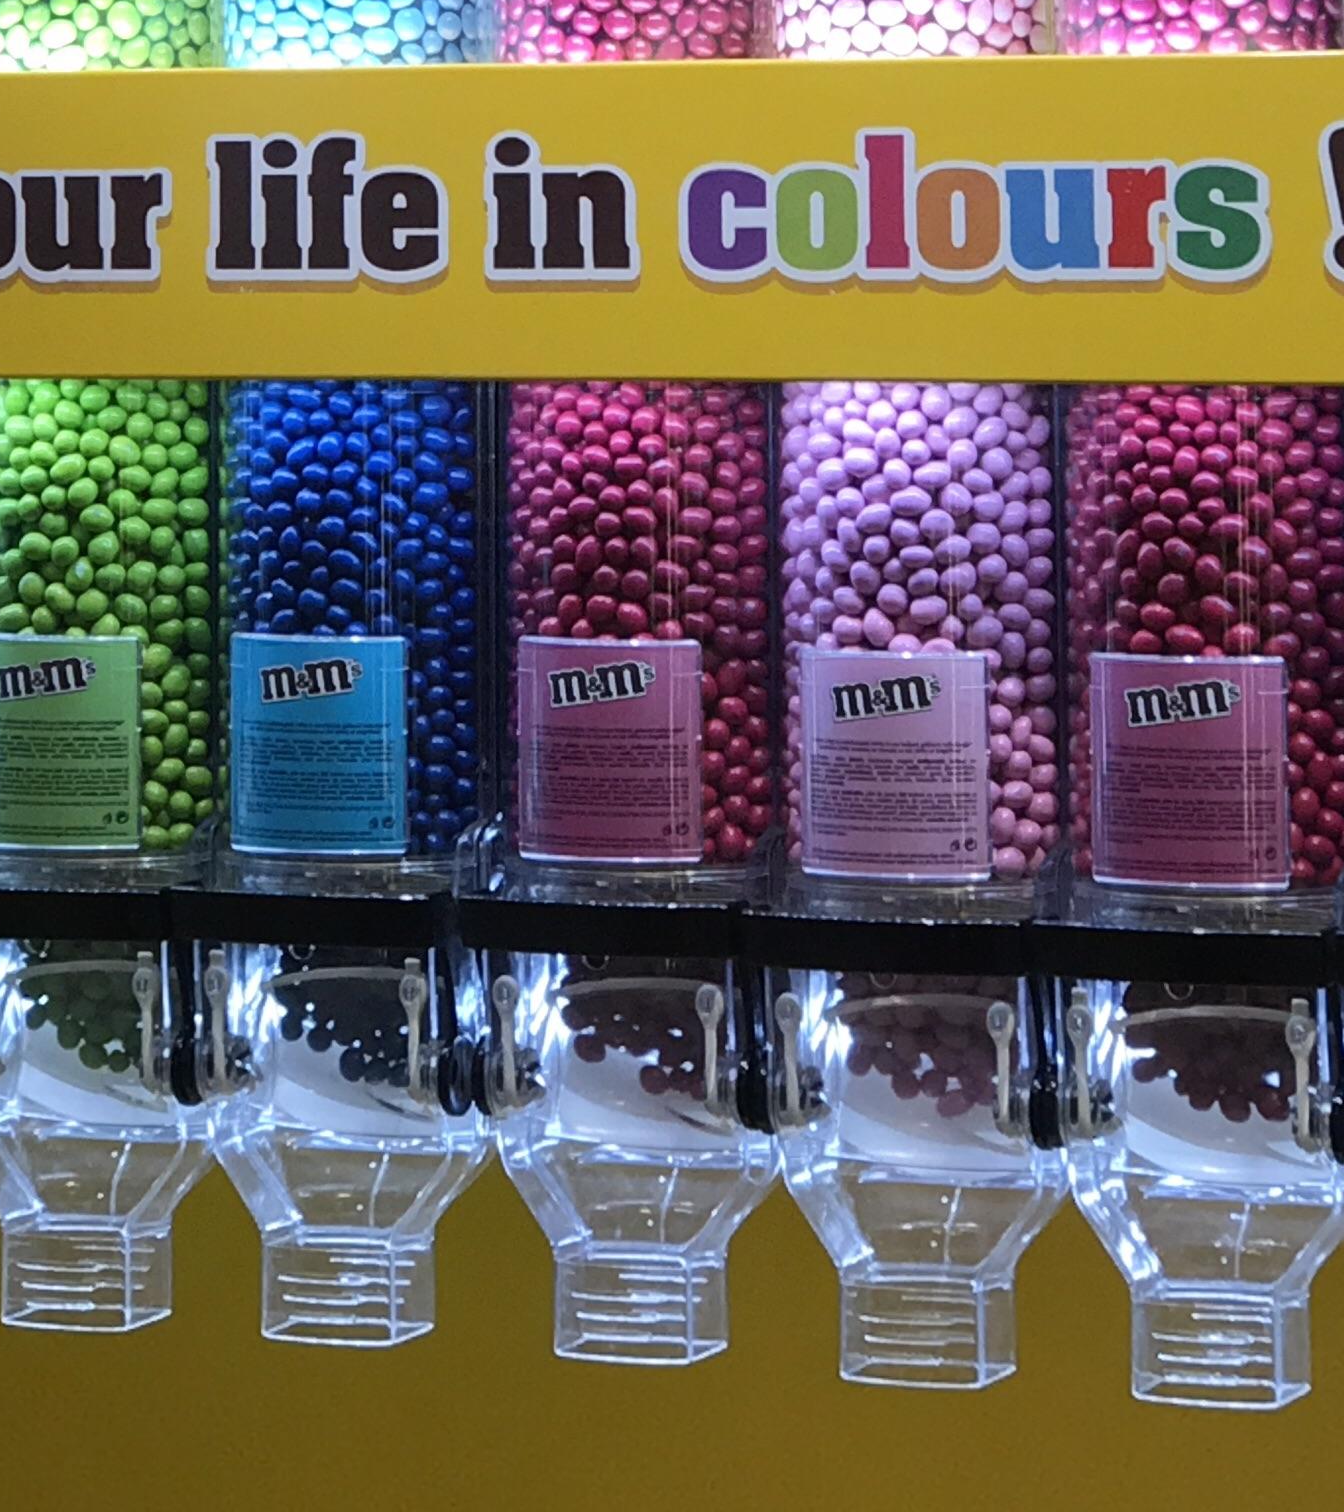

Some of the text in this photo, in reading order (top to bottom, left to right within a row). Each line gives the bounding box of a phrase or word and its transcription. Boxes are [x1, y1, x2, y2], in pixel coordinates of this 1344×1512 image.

[212, 135, 442, 272] life
[491, 136, 633, 272] in
[686, 133, 1263, 273] colours
